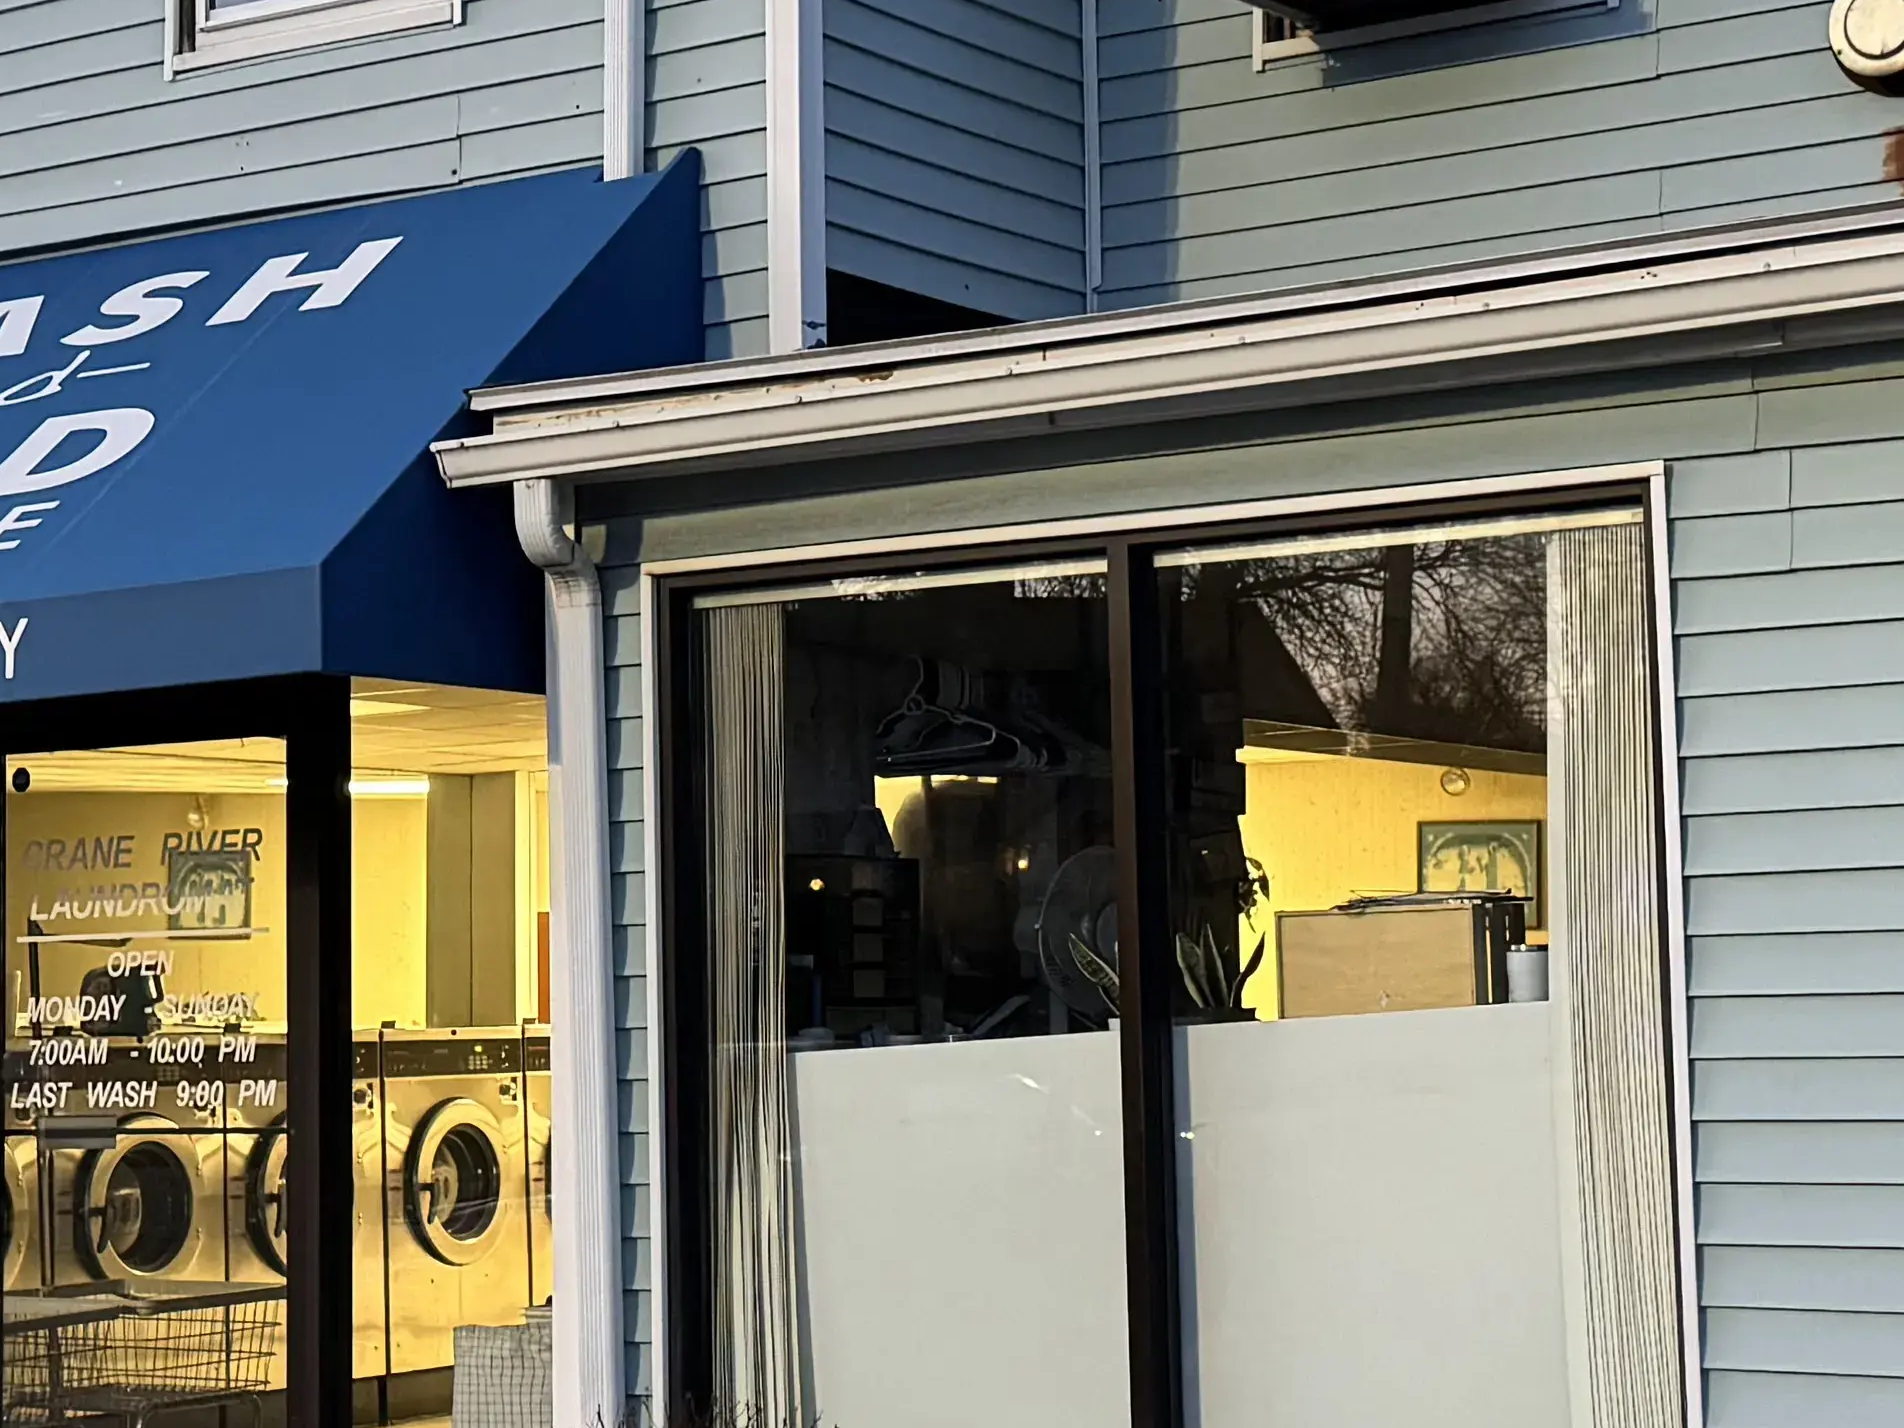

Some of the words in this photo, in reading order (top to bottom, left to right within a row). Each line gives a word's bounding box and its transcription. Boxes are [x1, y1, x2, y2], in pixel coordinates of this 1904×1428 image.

[21, 835, 135, 871] CRANE
[161, 828, 264, 866] RIVER
[107, 950, 175, 977] OPEN
[27, 994, 126, 1022] MONDAY
[163, 992, 259, 1018] SUNDAY
[28, 1038, 109, 1065] 7:00AM
[148, 1037, 204, 1064] 10:00
[218, 1036, 257, 1063] PM
[10, 1082, 73, 1109] LAST
[87, 1081, 158, 1108] WASH
[176, 1080, 225, 1107] 9:00
[238, 1079, 277, 1107] PM
